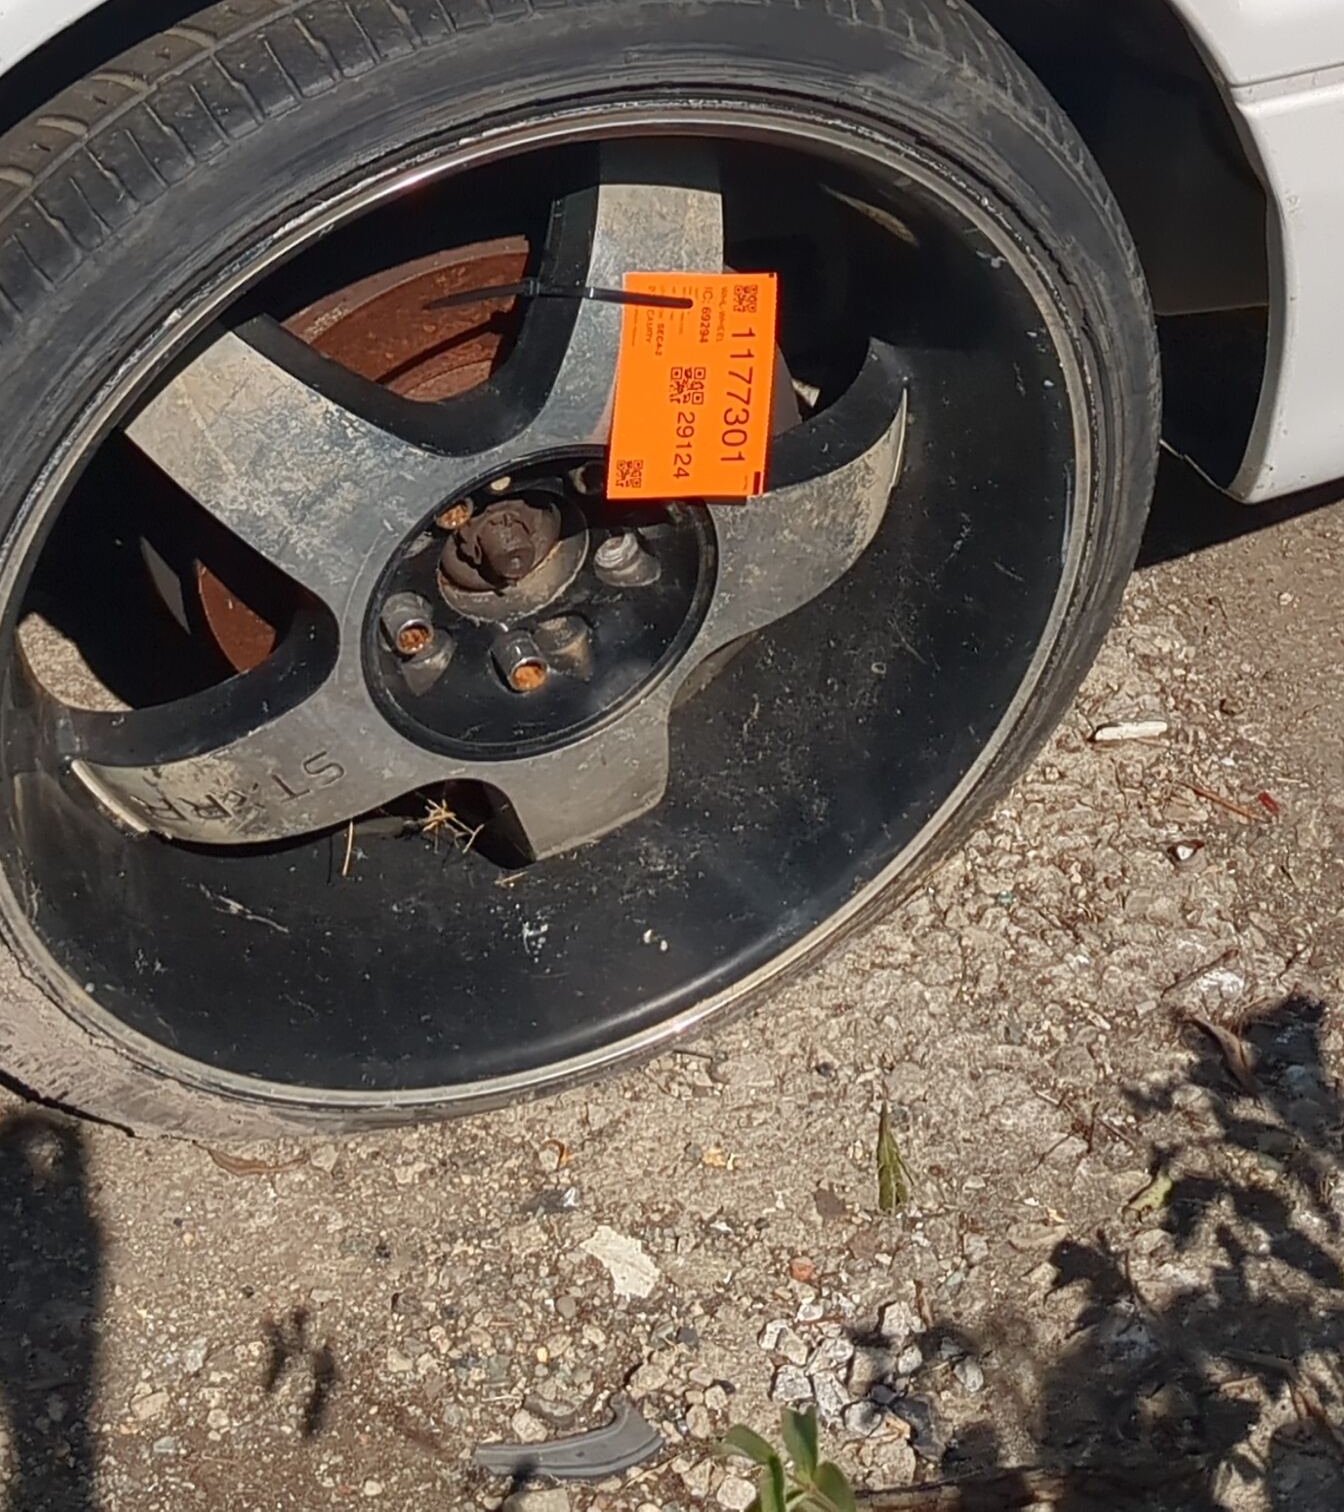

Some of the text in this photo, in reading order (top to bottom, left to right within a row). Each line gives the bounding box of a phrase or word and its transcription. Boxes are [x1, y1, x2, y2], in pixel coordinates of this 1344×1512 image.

[699, 286, 714, 344] IC: 69294
[720, 327, 756, 463] 1177301
[673, 411, 696, 480] 29124
